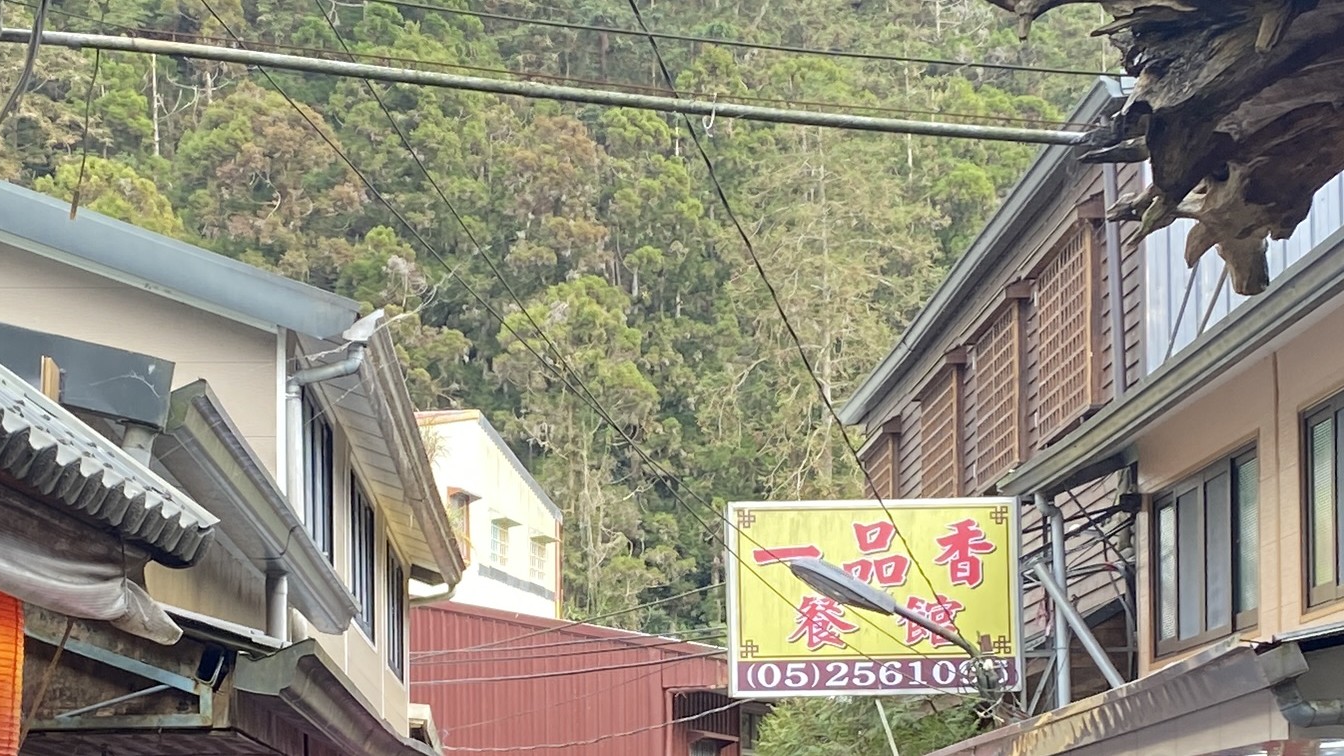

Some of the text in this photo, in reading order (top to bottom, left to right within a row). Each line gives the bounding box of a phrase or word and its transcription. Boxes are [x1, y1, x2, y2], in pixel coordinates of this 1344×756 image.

[752, 518, 997, 589] 一品香
[787, 594, 967, 651] 餐館
